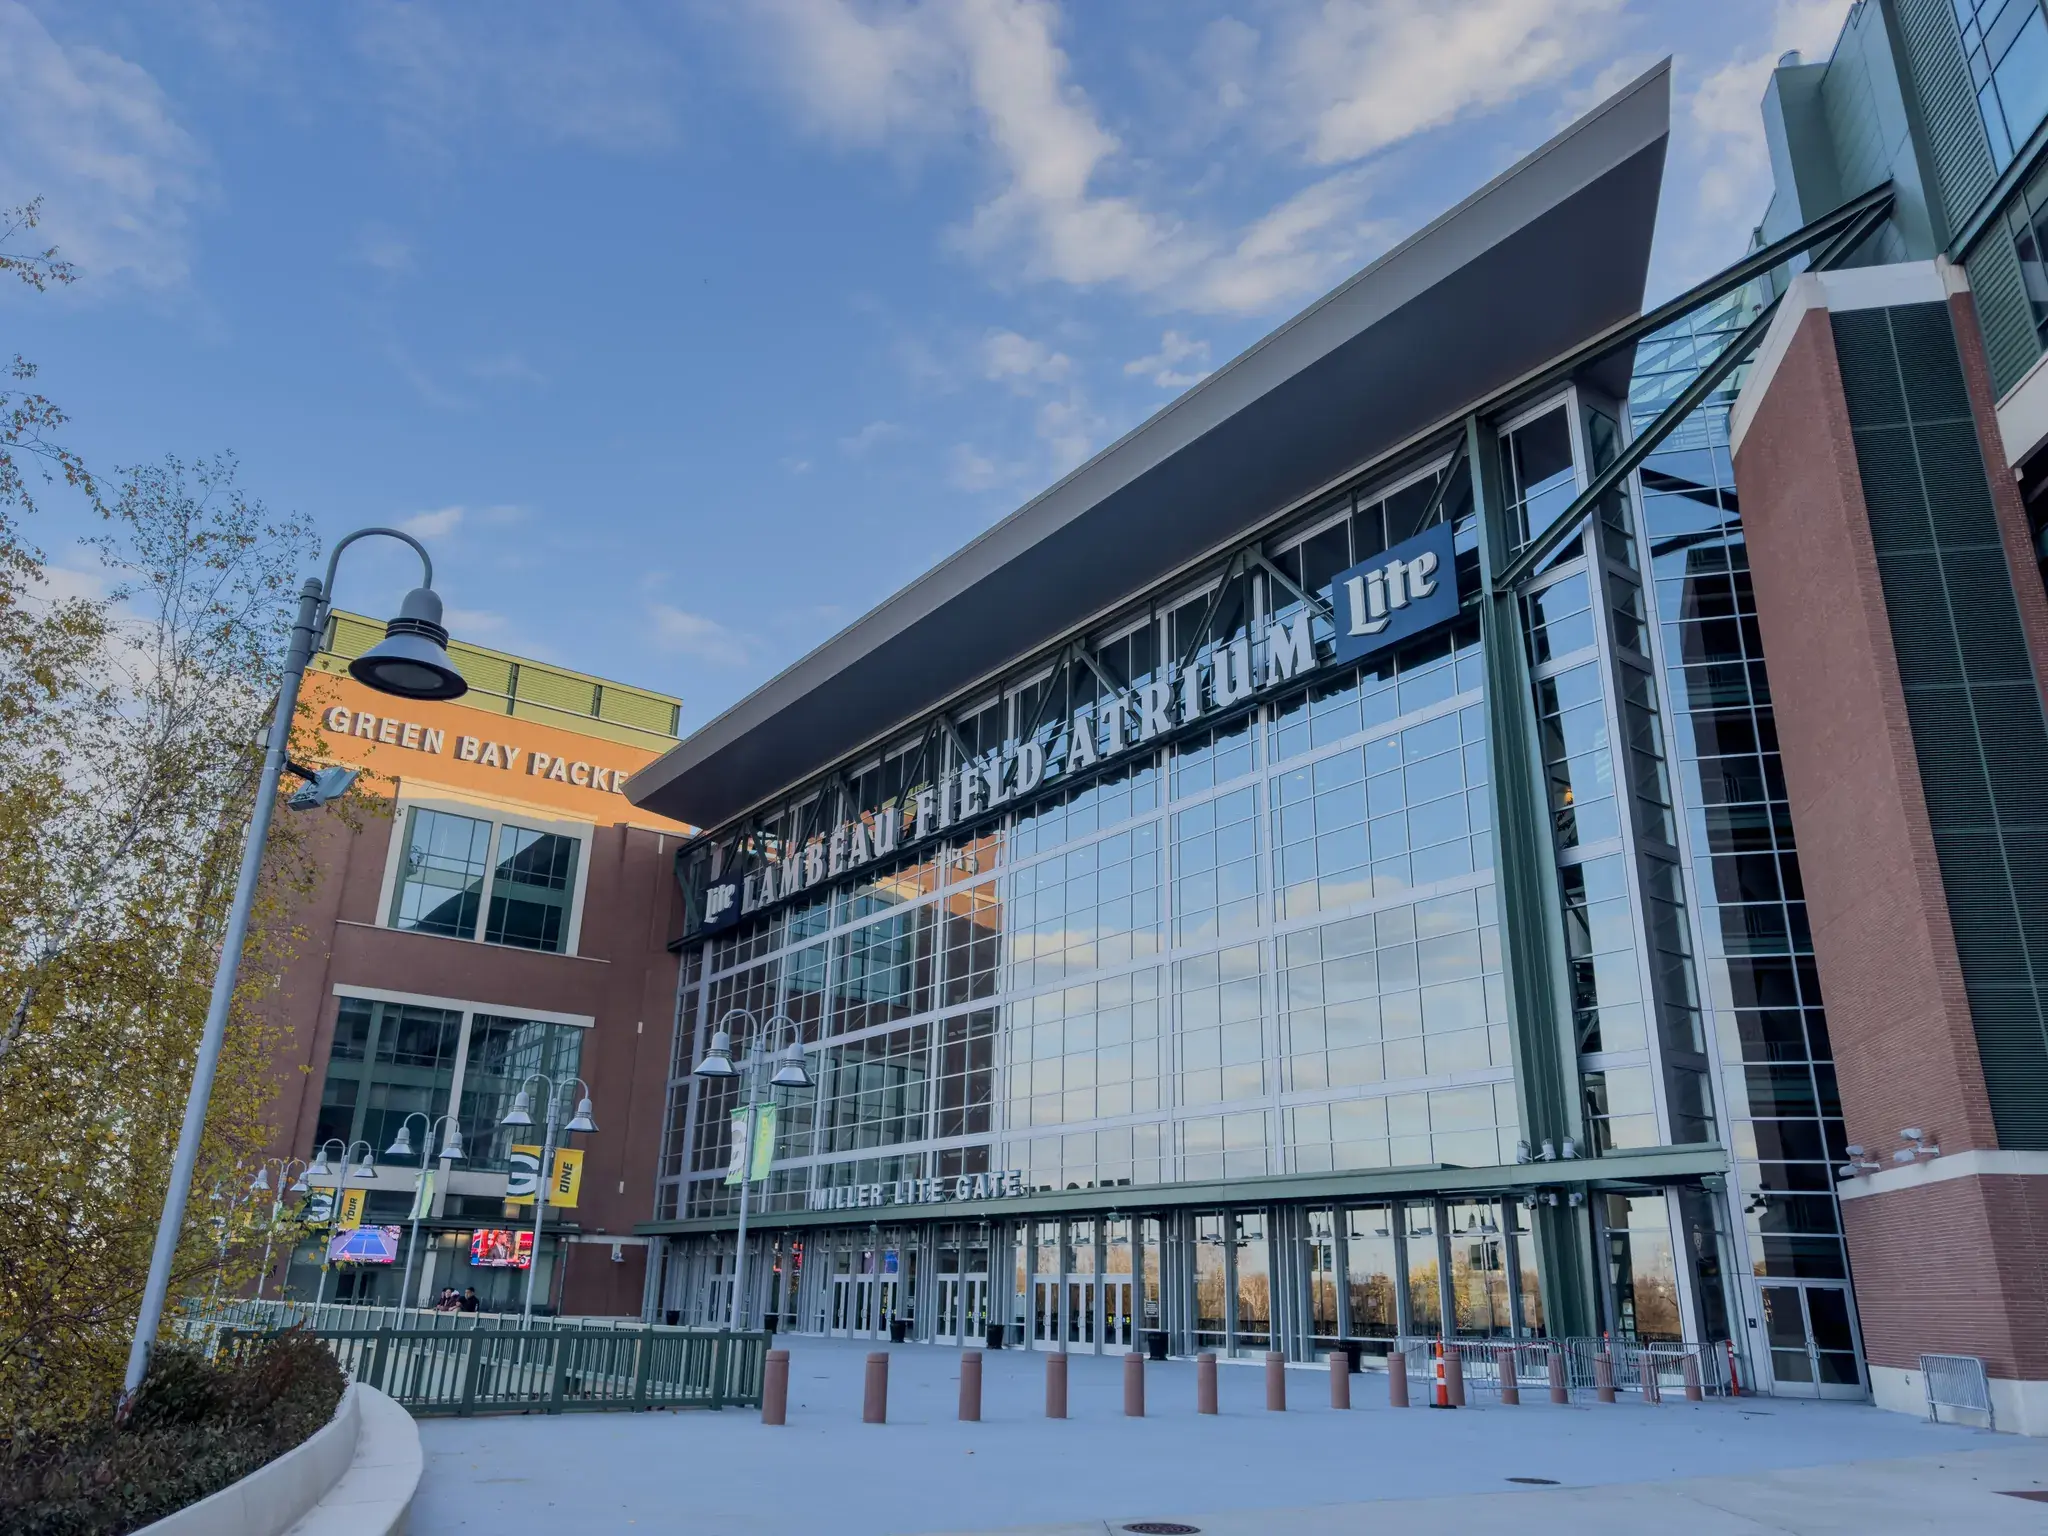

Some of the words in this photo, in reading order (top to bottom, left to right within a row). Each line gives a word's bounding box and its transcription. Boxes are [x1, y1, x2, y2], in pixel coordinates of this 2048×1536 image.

[1343, 551, 1440, 637] Lite
[325, 706, 445, 754] GREEN
[458, 735, 522, 770] BAY
[741, 808, 899, 915] LAMBEAU
[914, 741, 1047, 840] FIELD
[1065, 609, 1321, 775] ATRIUM
[703, 883, 737, 924] Lite
[559, 1161, 573, 1194] DINE
[812, 1183, 884, 1210] MILLER
[894, 1177, 946, 1205] LITE
[955, 1169, 1023, 1201] GATE
[346, 1197, 358, 1222] TOUR
